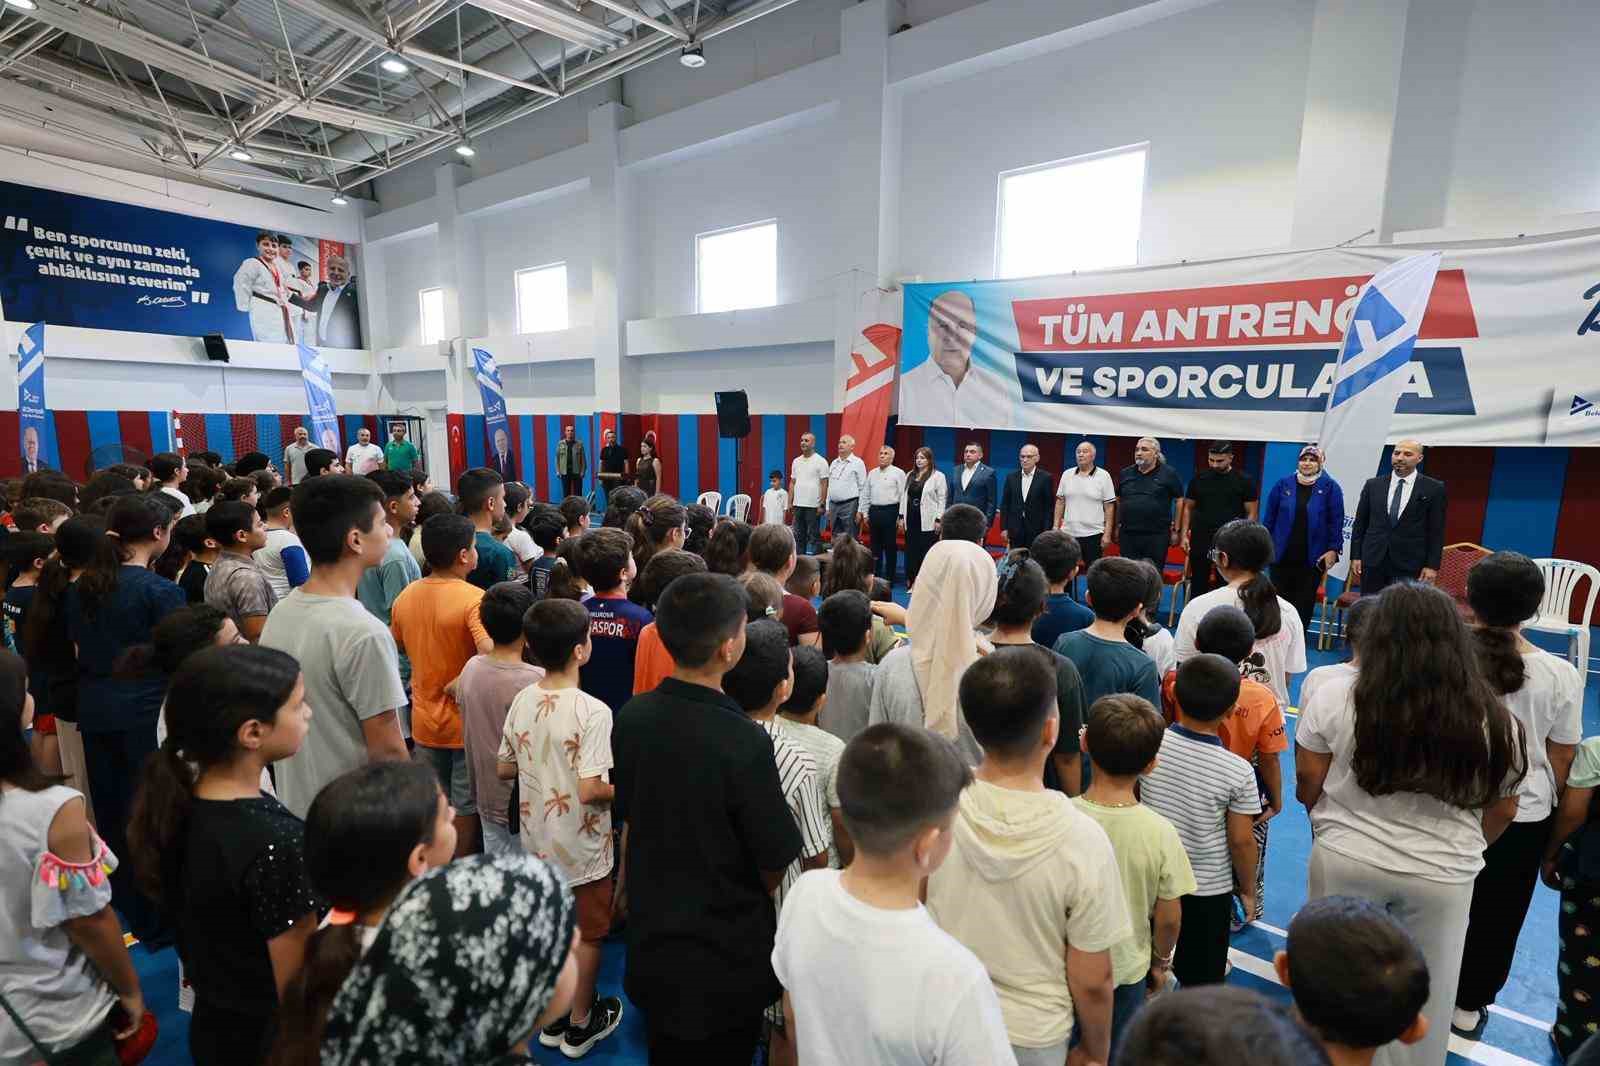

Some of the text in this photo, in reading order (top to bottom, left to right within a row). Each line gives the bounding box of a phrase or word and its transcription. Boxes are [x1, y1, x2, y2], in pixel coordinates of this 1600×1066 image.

[25, 244, 201, 279] çevik ve aynı zamanda
[33, 226, 191, 263] Ben sporcunun zeki,
[1038, 303, 1124, 345] TÜM
[1035, 366, 1084, 397] VE
